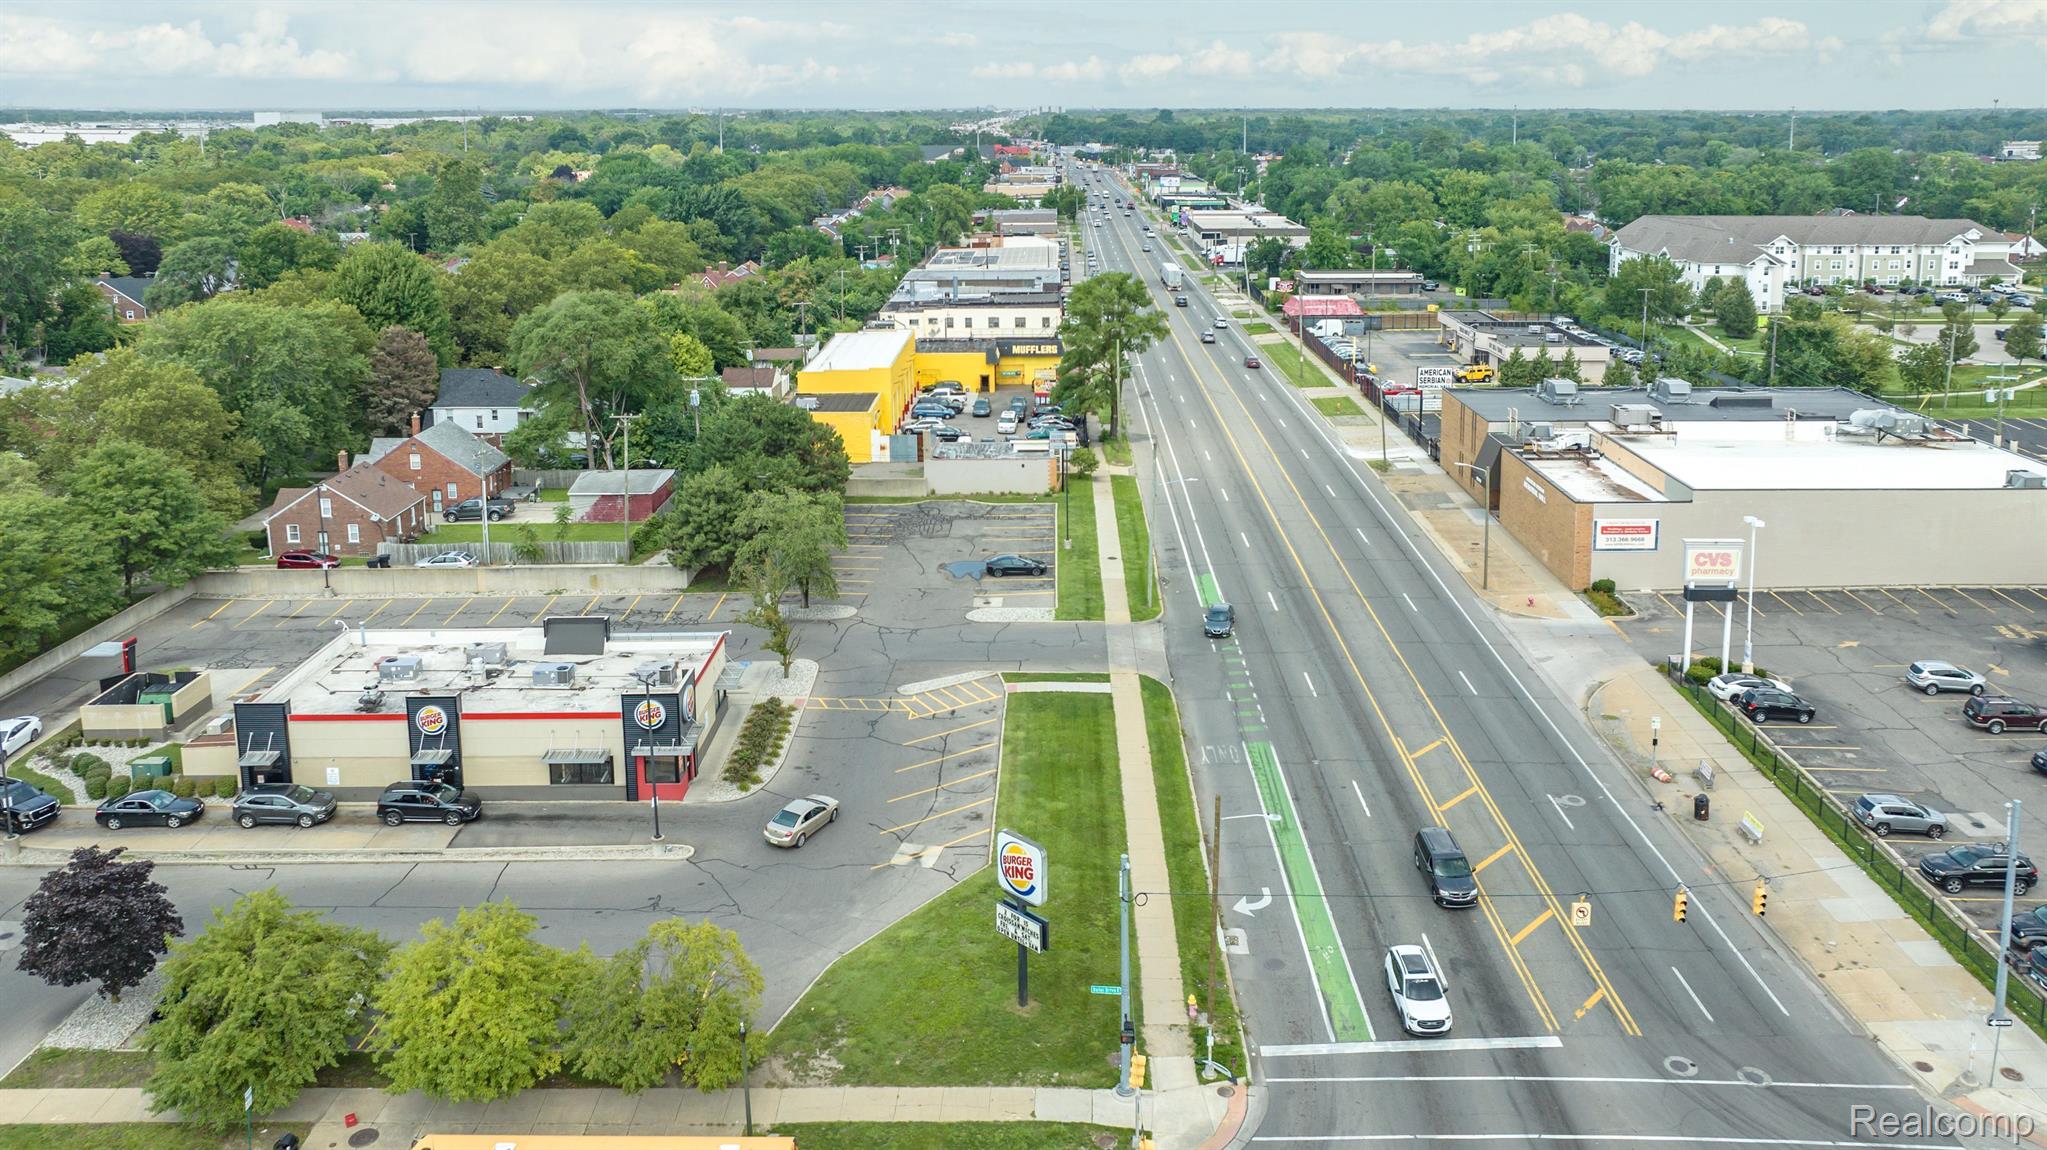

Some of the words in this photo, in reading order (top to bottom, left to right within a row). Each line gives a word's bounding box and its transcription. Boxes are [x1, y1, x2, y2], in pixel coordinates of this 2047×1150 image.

[1012, 345, 1058, 354] MUFFLERS
[1694, 552, 1732, 567] CVS
[1691, 568, 1735, 577] pharmacy
[420, 712, 442, 721] BURGER
[421, 717, 443, 727] KING
[1200, 745, 1240, 764] ONLY
[1003, 855, 1032, 867] BURGER
[1004, 865, 1034, 881] KING
[1010, 913, 1020, 922] FOR
[997, 925, 1010, 936] OPEN
